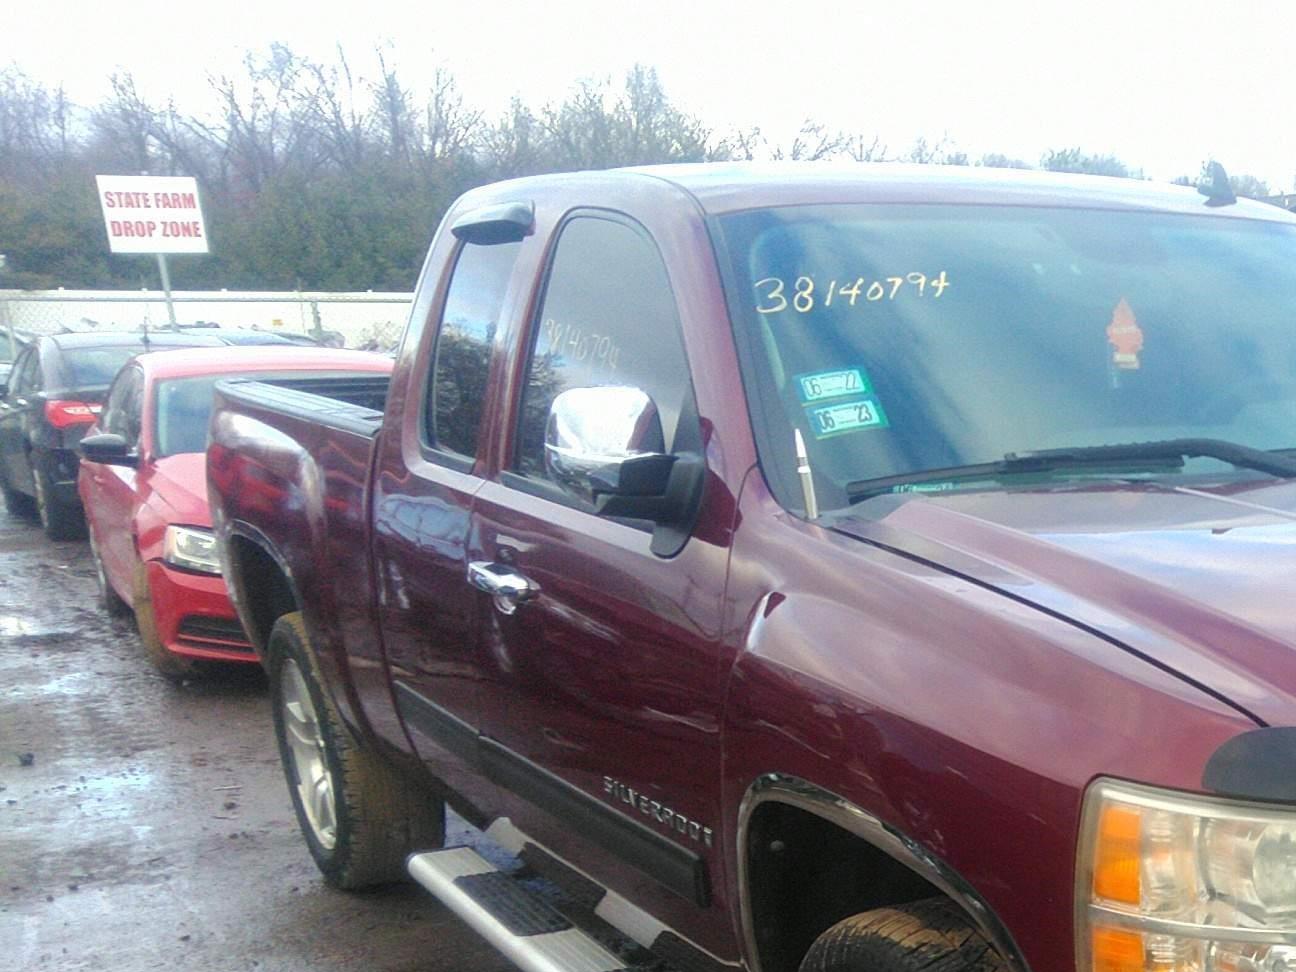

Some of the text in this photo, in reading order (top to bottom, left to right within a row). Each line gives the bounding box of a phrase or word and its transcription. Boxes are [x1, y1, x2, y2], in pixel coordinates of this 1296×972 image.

[104, 191, 197, 209] STATE FARM
[110, 220, 202, 238] DROP ZONE
[754, 271, 951, 313] 38140794
[854, 403, 873, 423] 23
